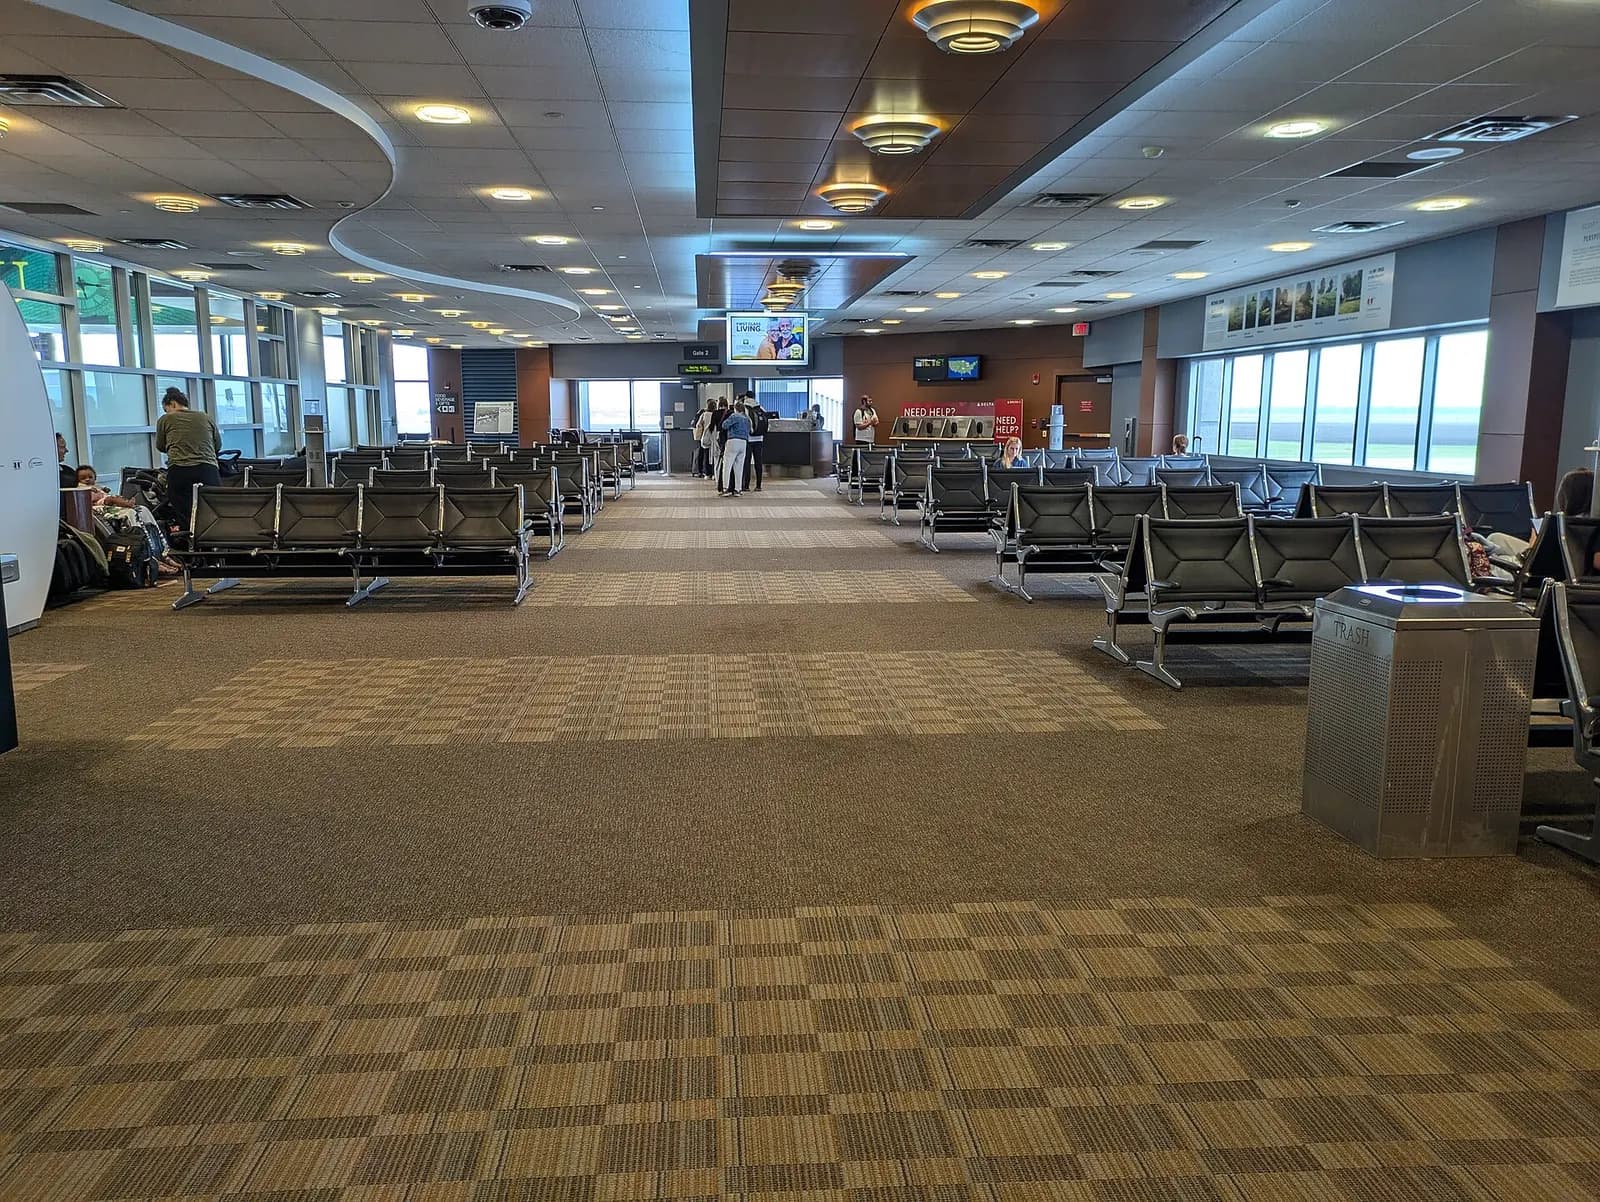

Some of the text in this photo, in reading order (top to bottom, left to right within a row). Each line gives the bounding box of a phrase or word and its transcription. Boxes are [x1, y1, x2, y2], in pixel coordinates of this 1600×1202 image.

[904, 407, 956, 417] NEED HELP?
[996, 416, 1017, 425] NEED
[996, 425, 1019, 434] HELP?
[1333, 620, 1370, 647] TRASH
